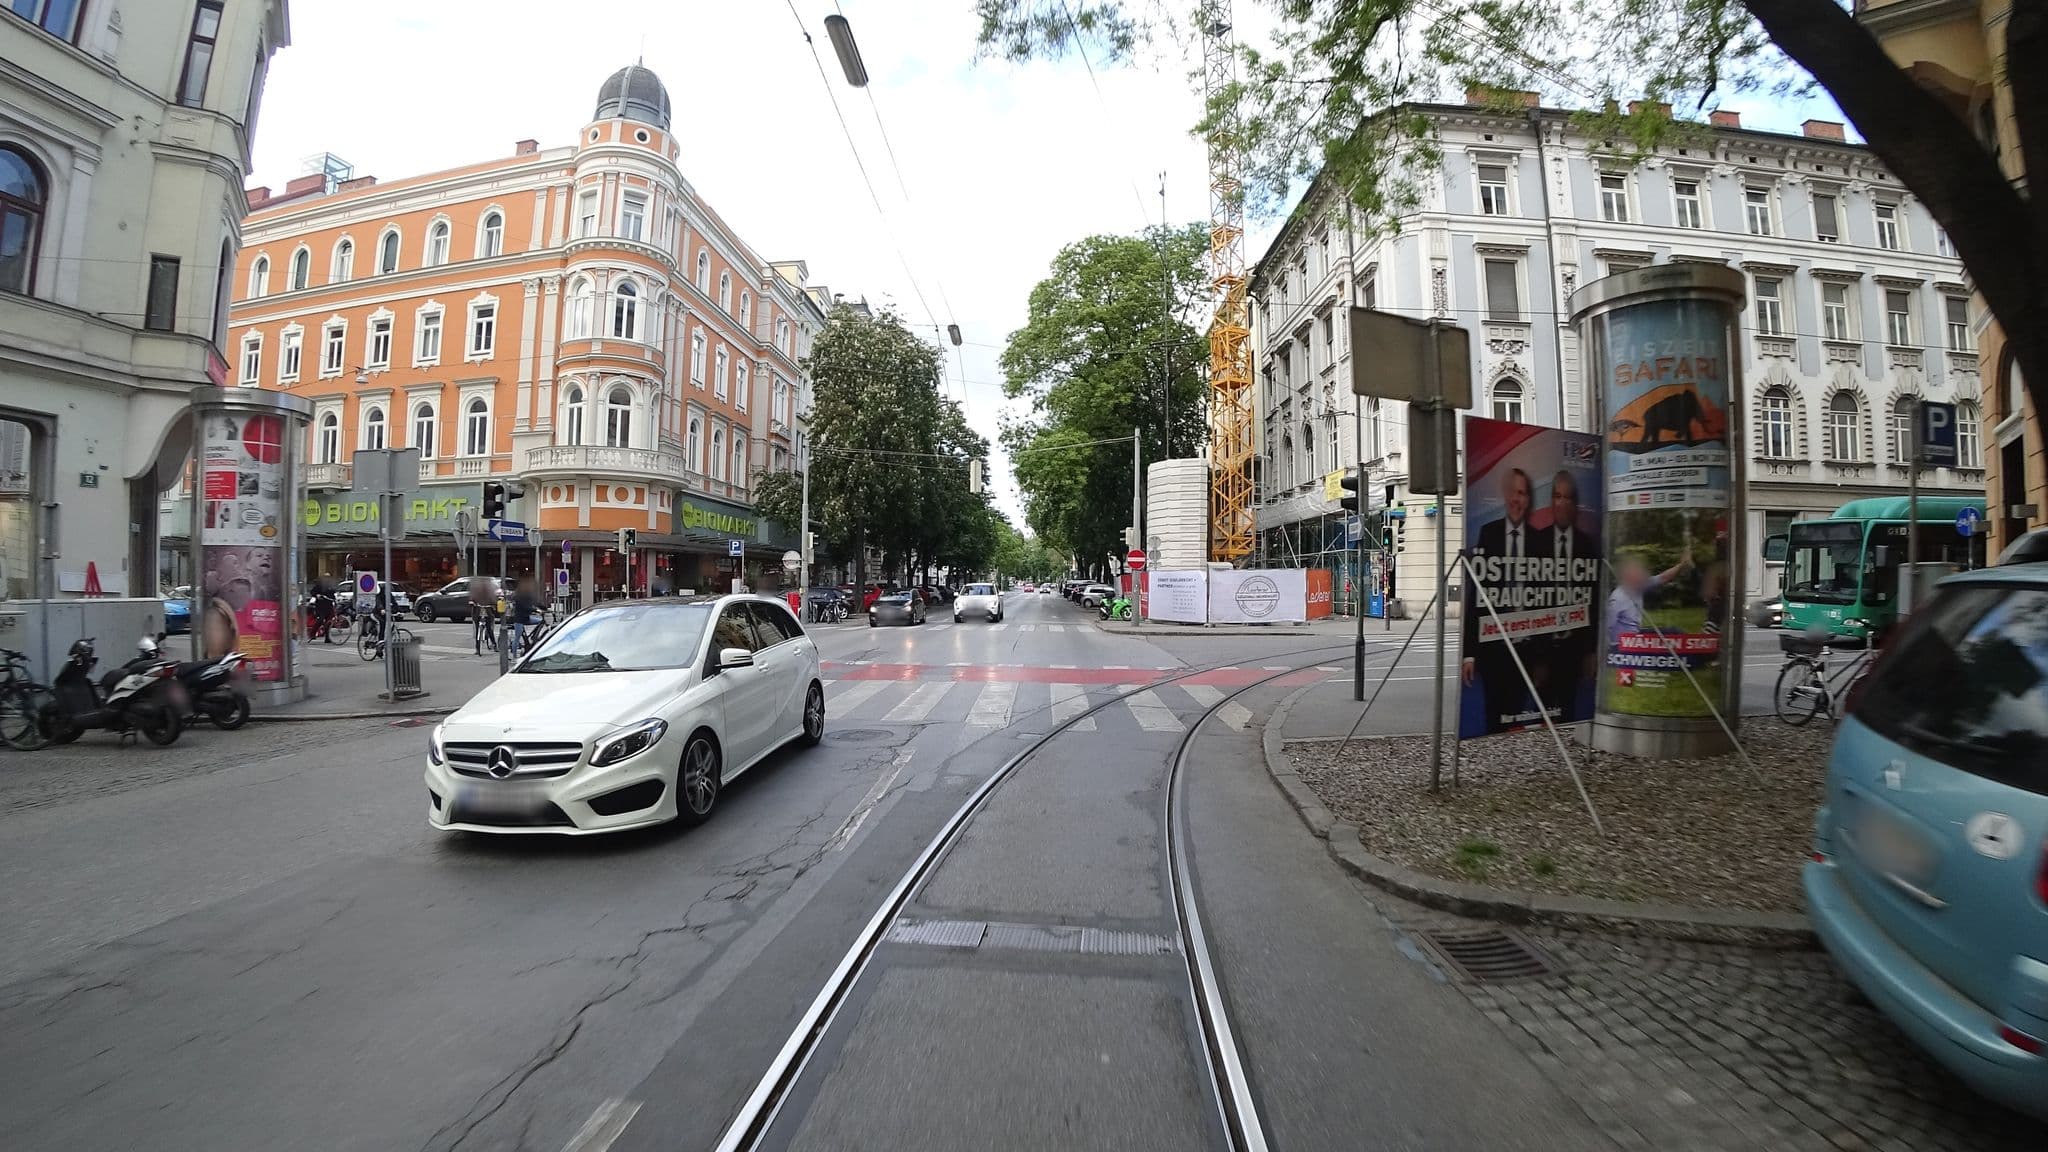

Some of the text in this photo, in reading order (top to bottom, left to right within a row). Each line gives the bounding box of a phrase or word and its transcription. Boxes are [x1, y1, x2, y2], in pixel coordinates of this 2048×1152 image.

[1615, 356, 1719, 387] SAFARI
[1928, 407, 1949, 441] P
[501, 527, 523, 536] EINBAHN
[694, 507, 757, 537] BIOMARKT
[731, 541, 740, 551] P
[1471, 547, 1598, 582] ÖSTERREICH
[1557, 586, 1592, 606] DICH
[1510, 618, 1530, 631] erst
[1532, 613, 1557, 628] recht
[1620, 634, 1682, 650] WÄHLEN
